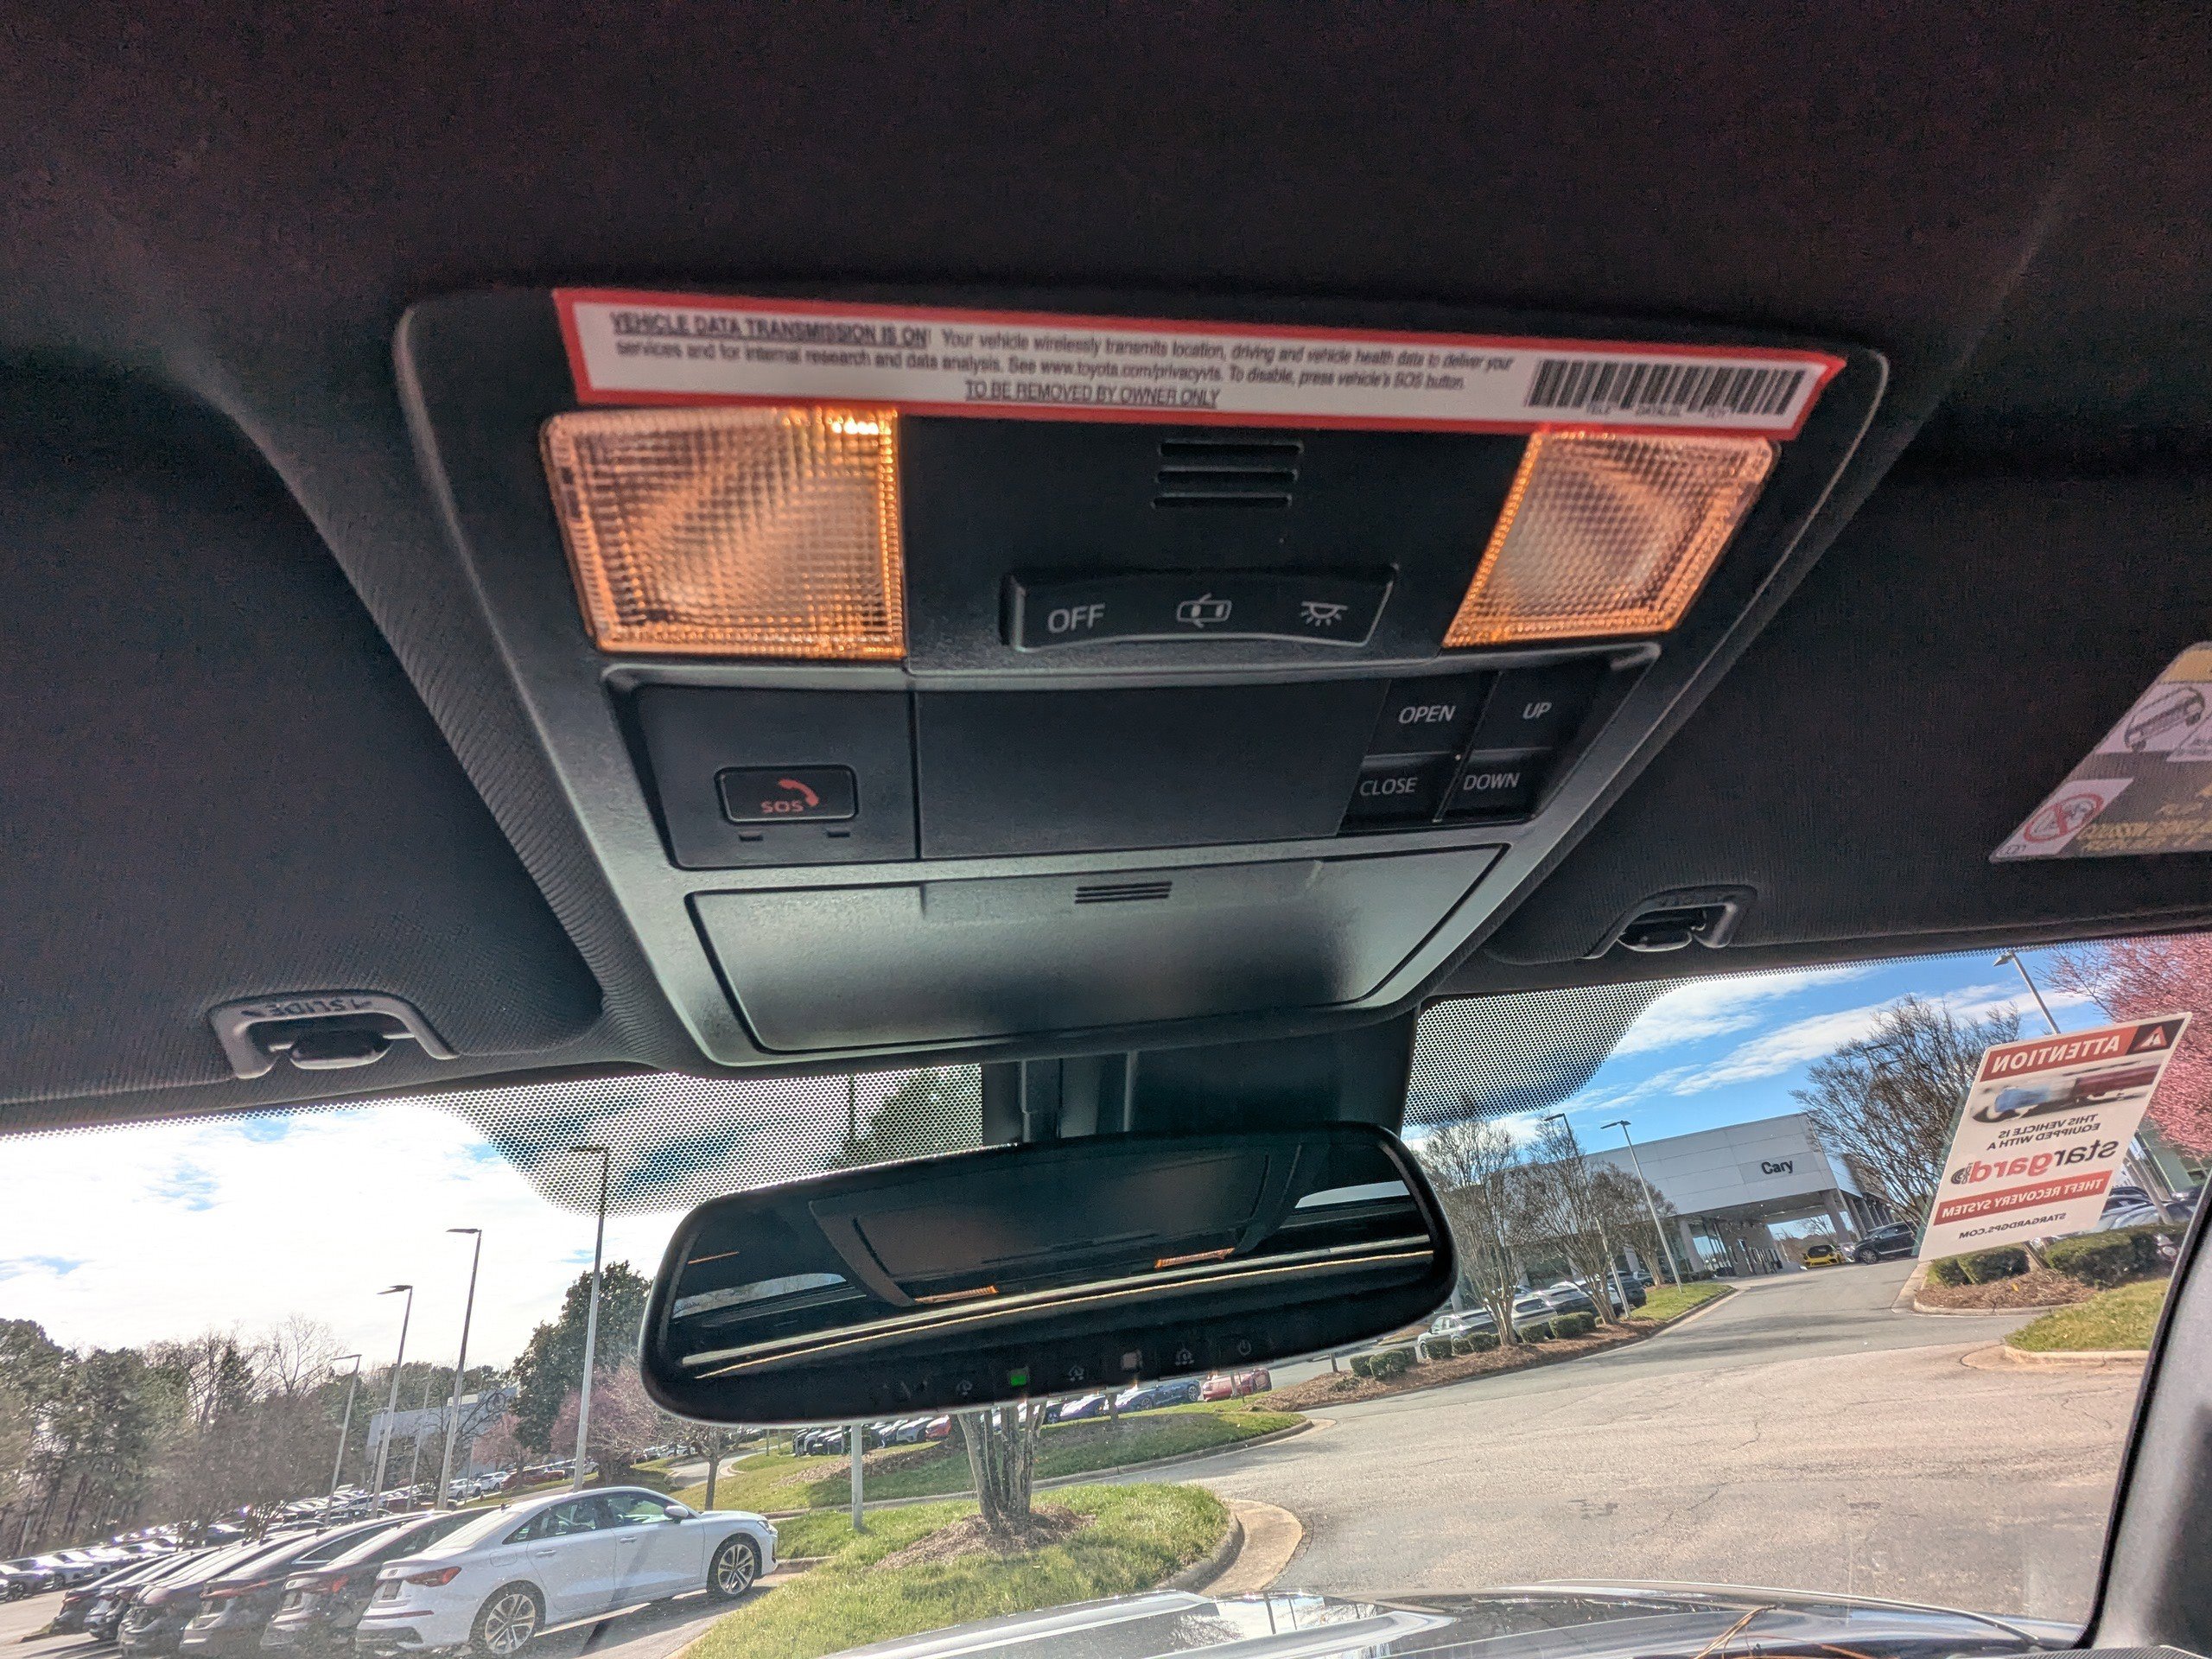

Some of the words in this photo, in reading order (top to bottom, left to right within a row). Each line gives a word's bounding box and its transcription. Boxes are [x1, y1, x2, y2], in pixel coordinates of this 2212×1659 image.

[609, 312, 690, 334] VEHICLE
[694, 315, 741, 336] DATA
[746, 317, 876, 343] TRANSMISSION
[882, 325, 897, 346] IS
[941, 328, 973, 347] Your
[980, 331, 1029, 350] vehicle
[1034, 334, 1101, 358] wirelessly
[1106, 338, 1167, 357] transmits
[1173, 340, 1226, 362] location,
[1231, 344, 1276, 365] driving
[1279, 346, 1306, 363] and
[1306, 347, 1352, 365] vehicle
[1355, 349, 1394, 365] health
[1397, 350, 1425, 366] data
[1427, 353, 1441, 368] to
[1442, 352, 1483, 369] deliver
[1485, 356, 1515, 373] your
[616, 342, 682, 358] services
[687, 343, 715, 359] and
[719, 343, 741, 360] for
[745, 345, 802, 365] internal
[805, 347, 872, 366] research
[875, 352, 902, 369] and
[906, 353, 938, 370] data
[1007, 355, 1037, 375] See
[1230, 363, 1244, 383] To
[1297, 370, 1335, 389] press
[1393, 372, 1425, 389] SOS
[964, 379, 988, 400] TO
[991, 381, 1014, 402] BE
[1016, 383, 1094, 404] REMOVED
[1096, 385, 1119, 406] BY
[1122, 386, 1179, 407] OWNER
[1180, 388, 1221, 409] ONLY
[1047, 603, 1106, 634] OFF
[1398, 704, 1457, 724] OPEN
[1522, 702, 1552, 720] UP
[1359, 777, 1418, 797] CLOSE
[1463, 772, 1521, 791] DOWN
[760, 800, 804, 814] SOS
[1761, 1160, 1794, 1175] Cary
